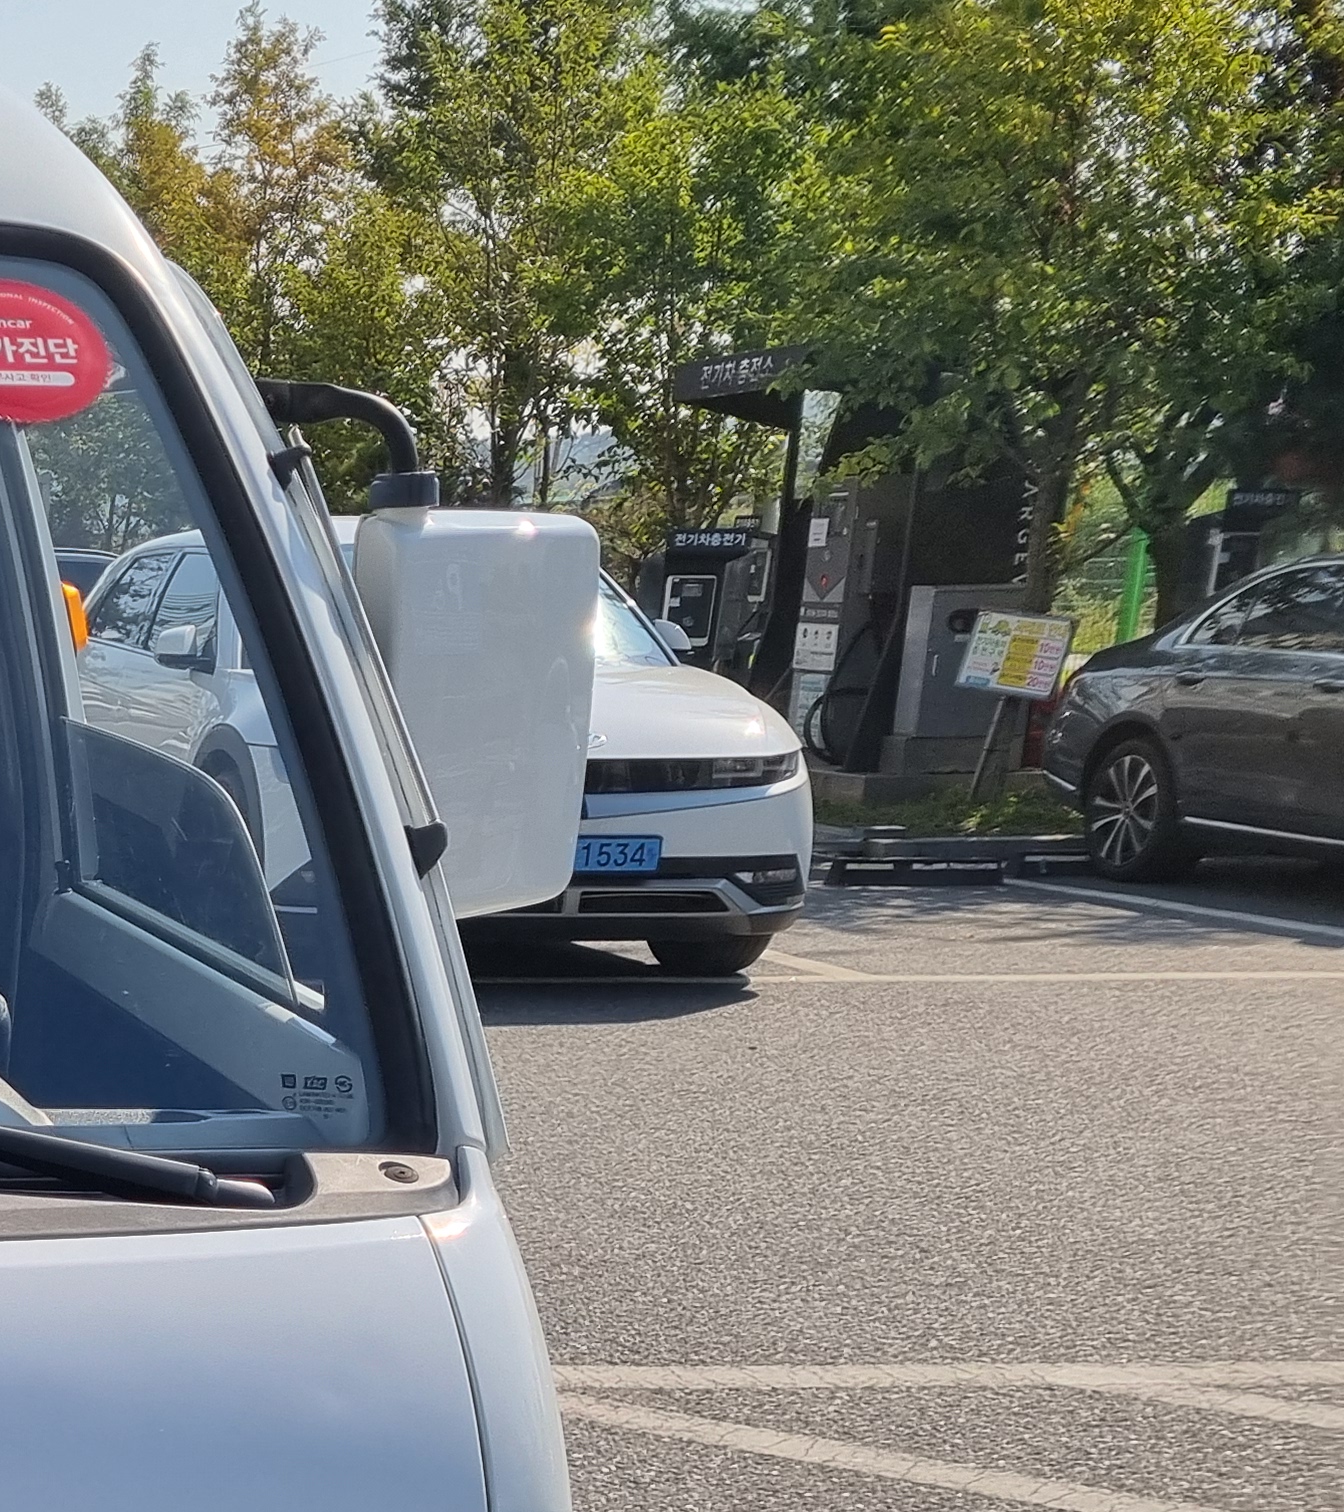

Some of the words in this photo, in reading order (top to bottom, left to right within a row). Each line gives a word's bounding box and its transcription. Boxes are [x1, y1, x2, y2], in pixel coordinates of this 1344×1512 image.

[28, 296, 75, 325] INSPECTION
[674, 532, 747, 547] 전기차충전기
[581, 842, 646, 867] 1534
